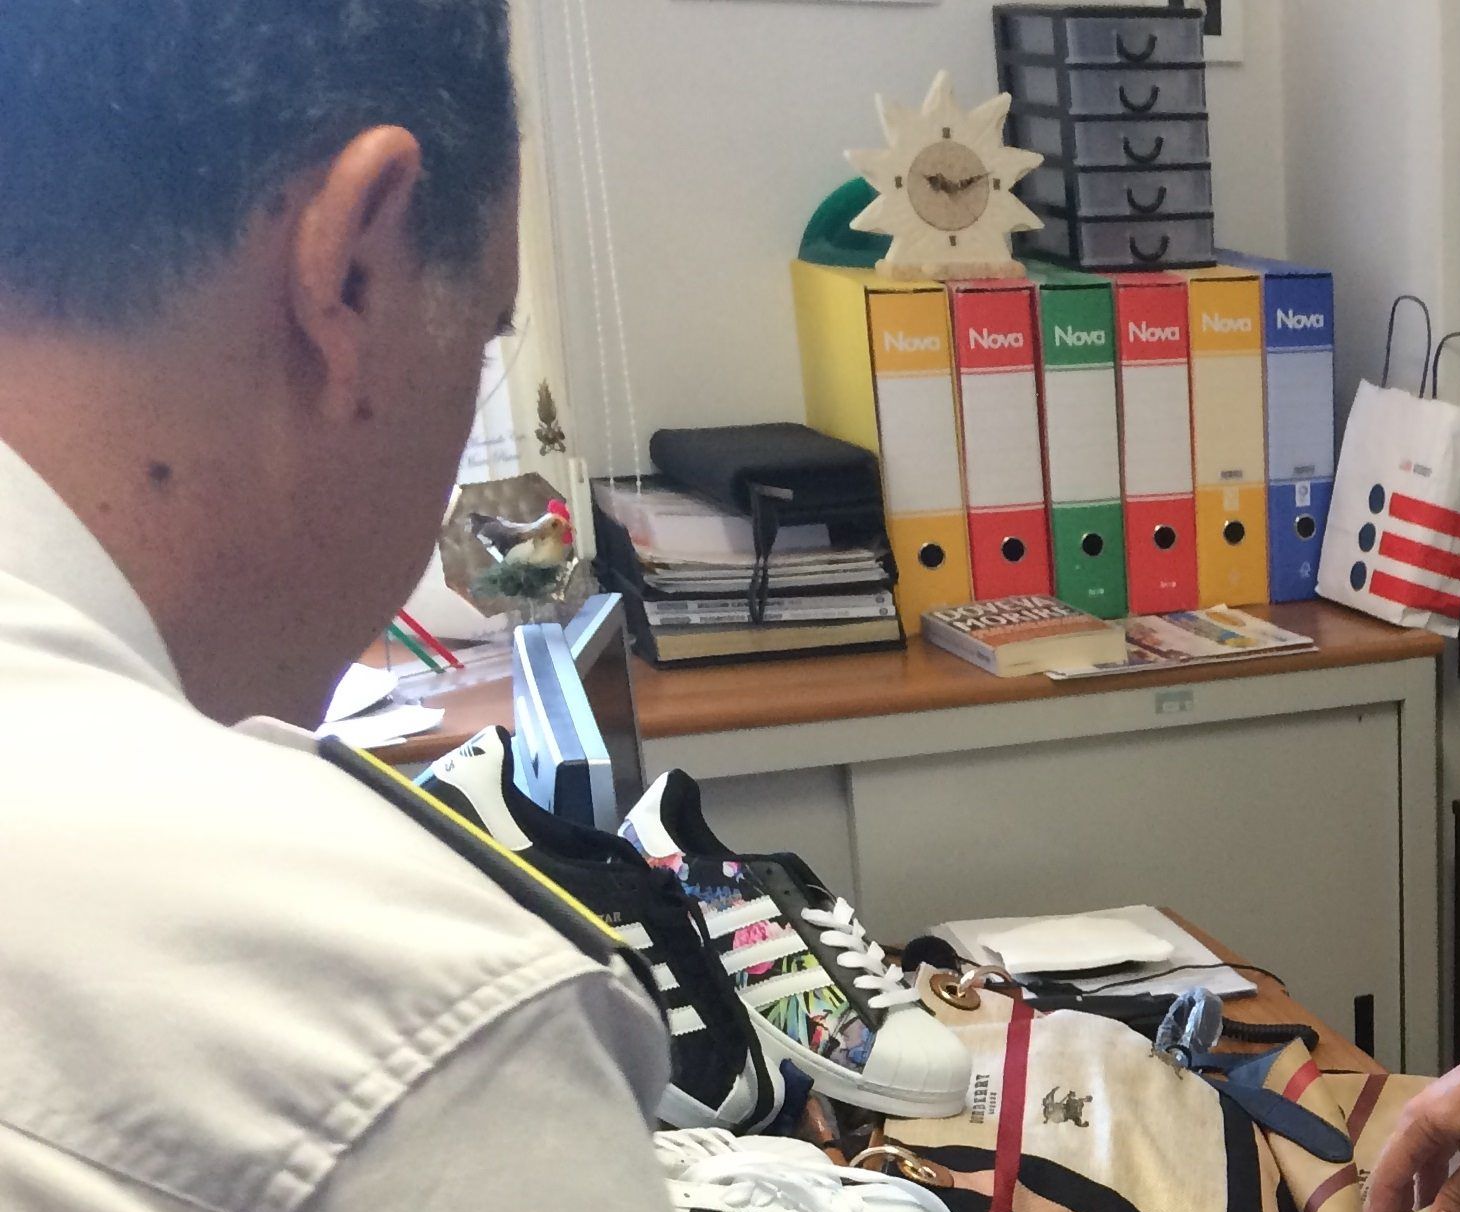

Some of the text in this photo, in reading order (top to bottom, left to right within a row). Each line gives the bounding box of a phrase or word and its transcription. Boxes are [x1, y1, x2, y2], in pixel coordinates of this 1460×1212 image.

[1202, 312, 1251, 333] Nova
[1276, 308, 1324, 329] Nova
[883, 330, 941, 352] Nova
[968, 327, 1024, 349] Nova
[1054, 325, 1105, 346] Nova
[1128, 321, 1180, 343] Nova
